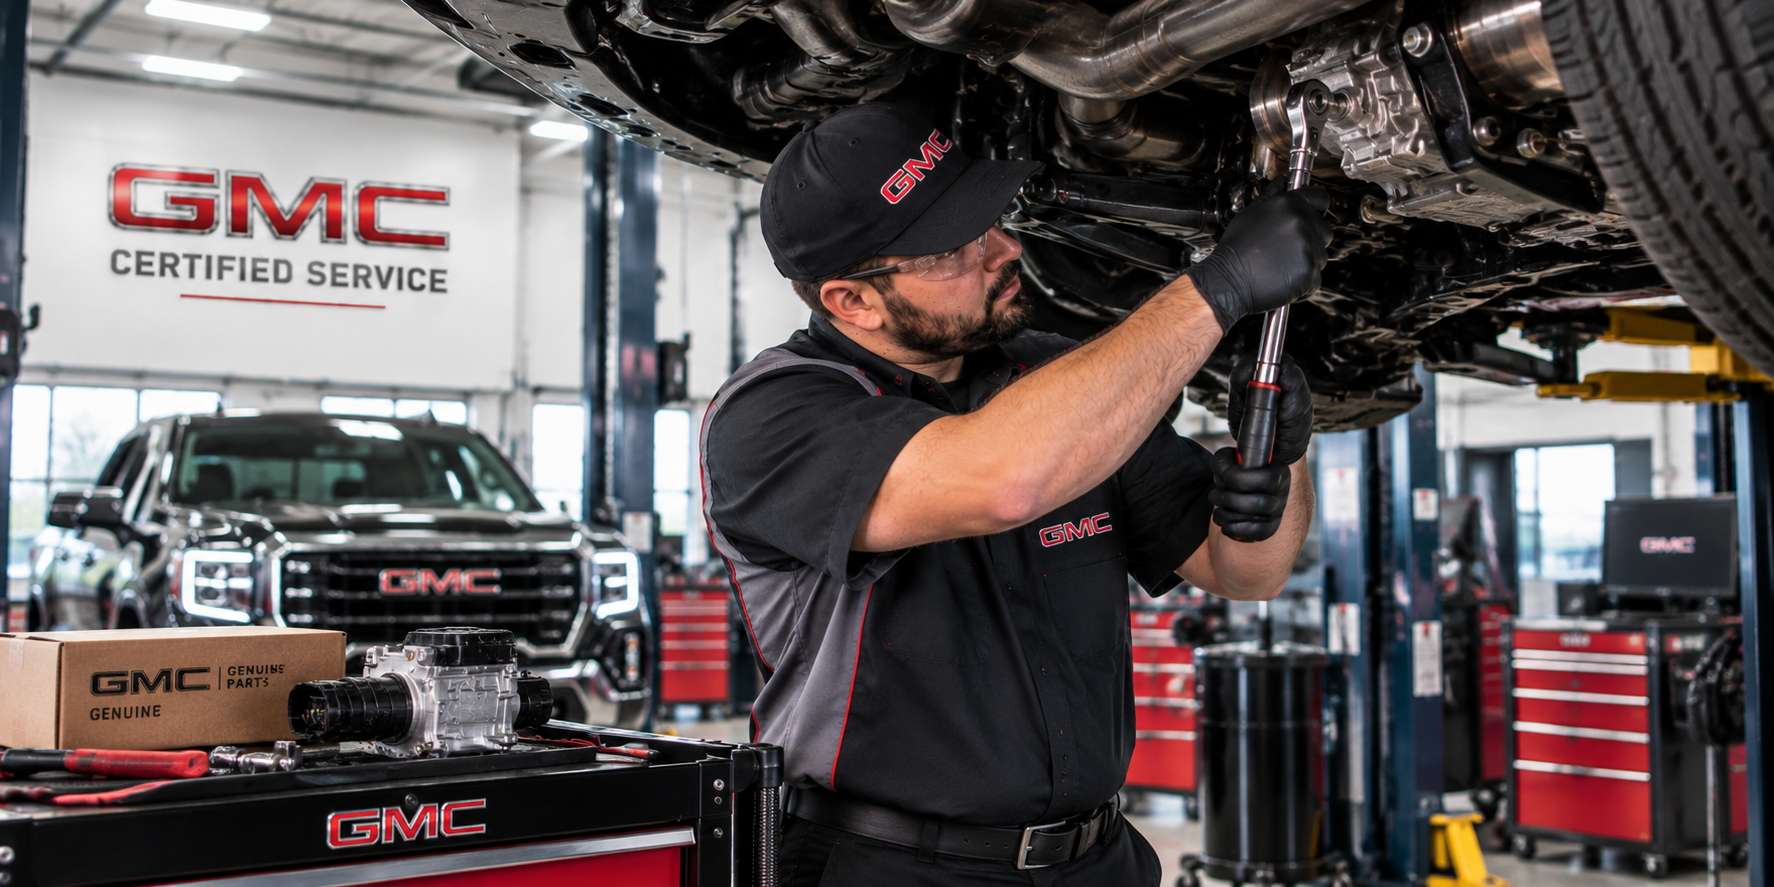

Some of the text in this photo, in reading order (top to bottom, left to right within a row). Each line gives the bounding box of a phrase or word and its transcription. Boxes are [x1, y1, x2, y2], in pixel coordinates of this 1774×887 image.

[880, 128, 953, 204] GMC
[108, 162, 451, 252] GMC
[110, 249, 449, 294] CERTIFIED SERVICE
[1039, 511, 1113, 548] GMC
[1640, 535, 1697, 555] GMC
[379, 567, 502, 596] GMC
[90, 667, 211, 697] GMC
[226, 677, 269, 690] PARTS
[89, 704, 162, 721] GENUINE
[326, 798, 487, 849] GMC
